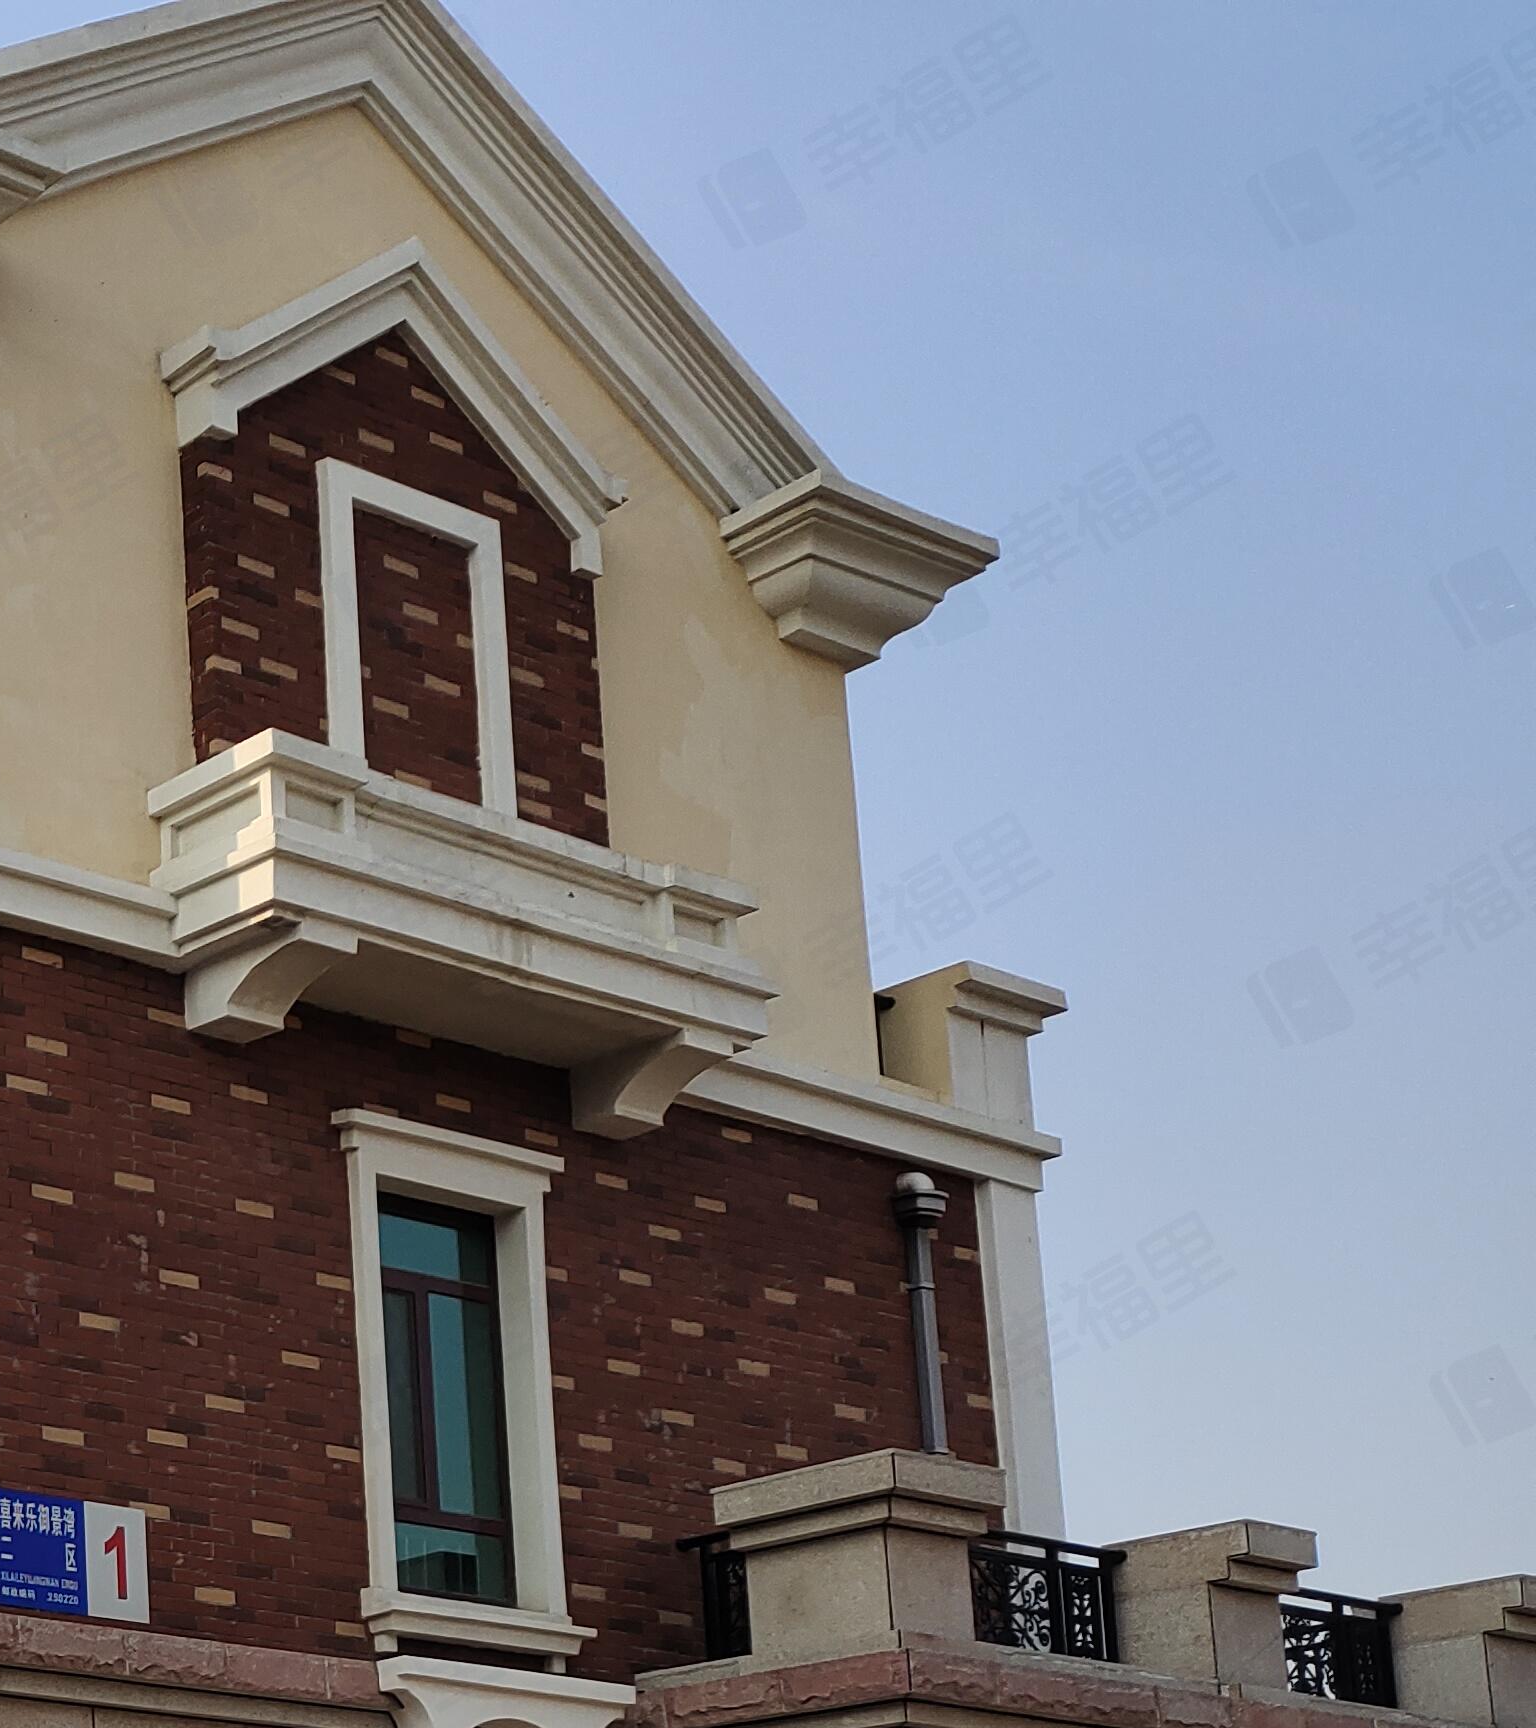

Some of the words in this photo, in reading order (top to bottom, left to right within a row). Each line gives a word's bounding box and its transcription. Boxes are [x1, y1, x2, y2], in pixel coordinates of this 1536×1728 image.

[0, 1497, 75, 1539] 喜来乐御景湾
[104, 1526, 128, 1600] 1
